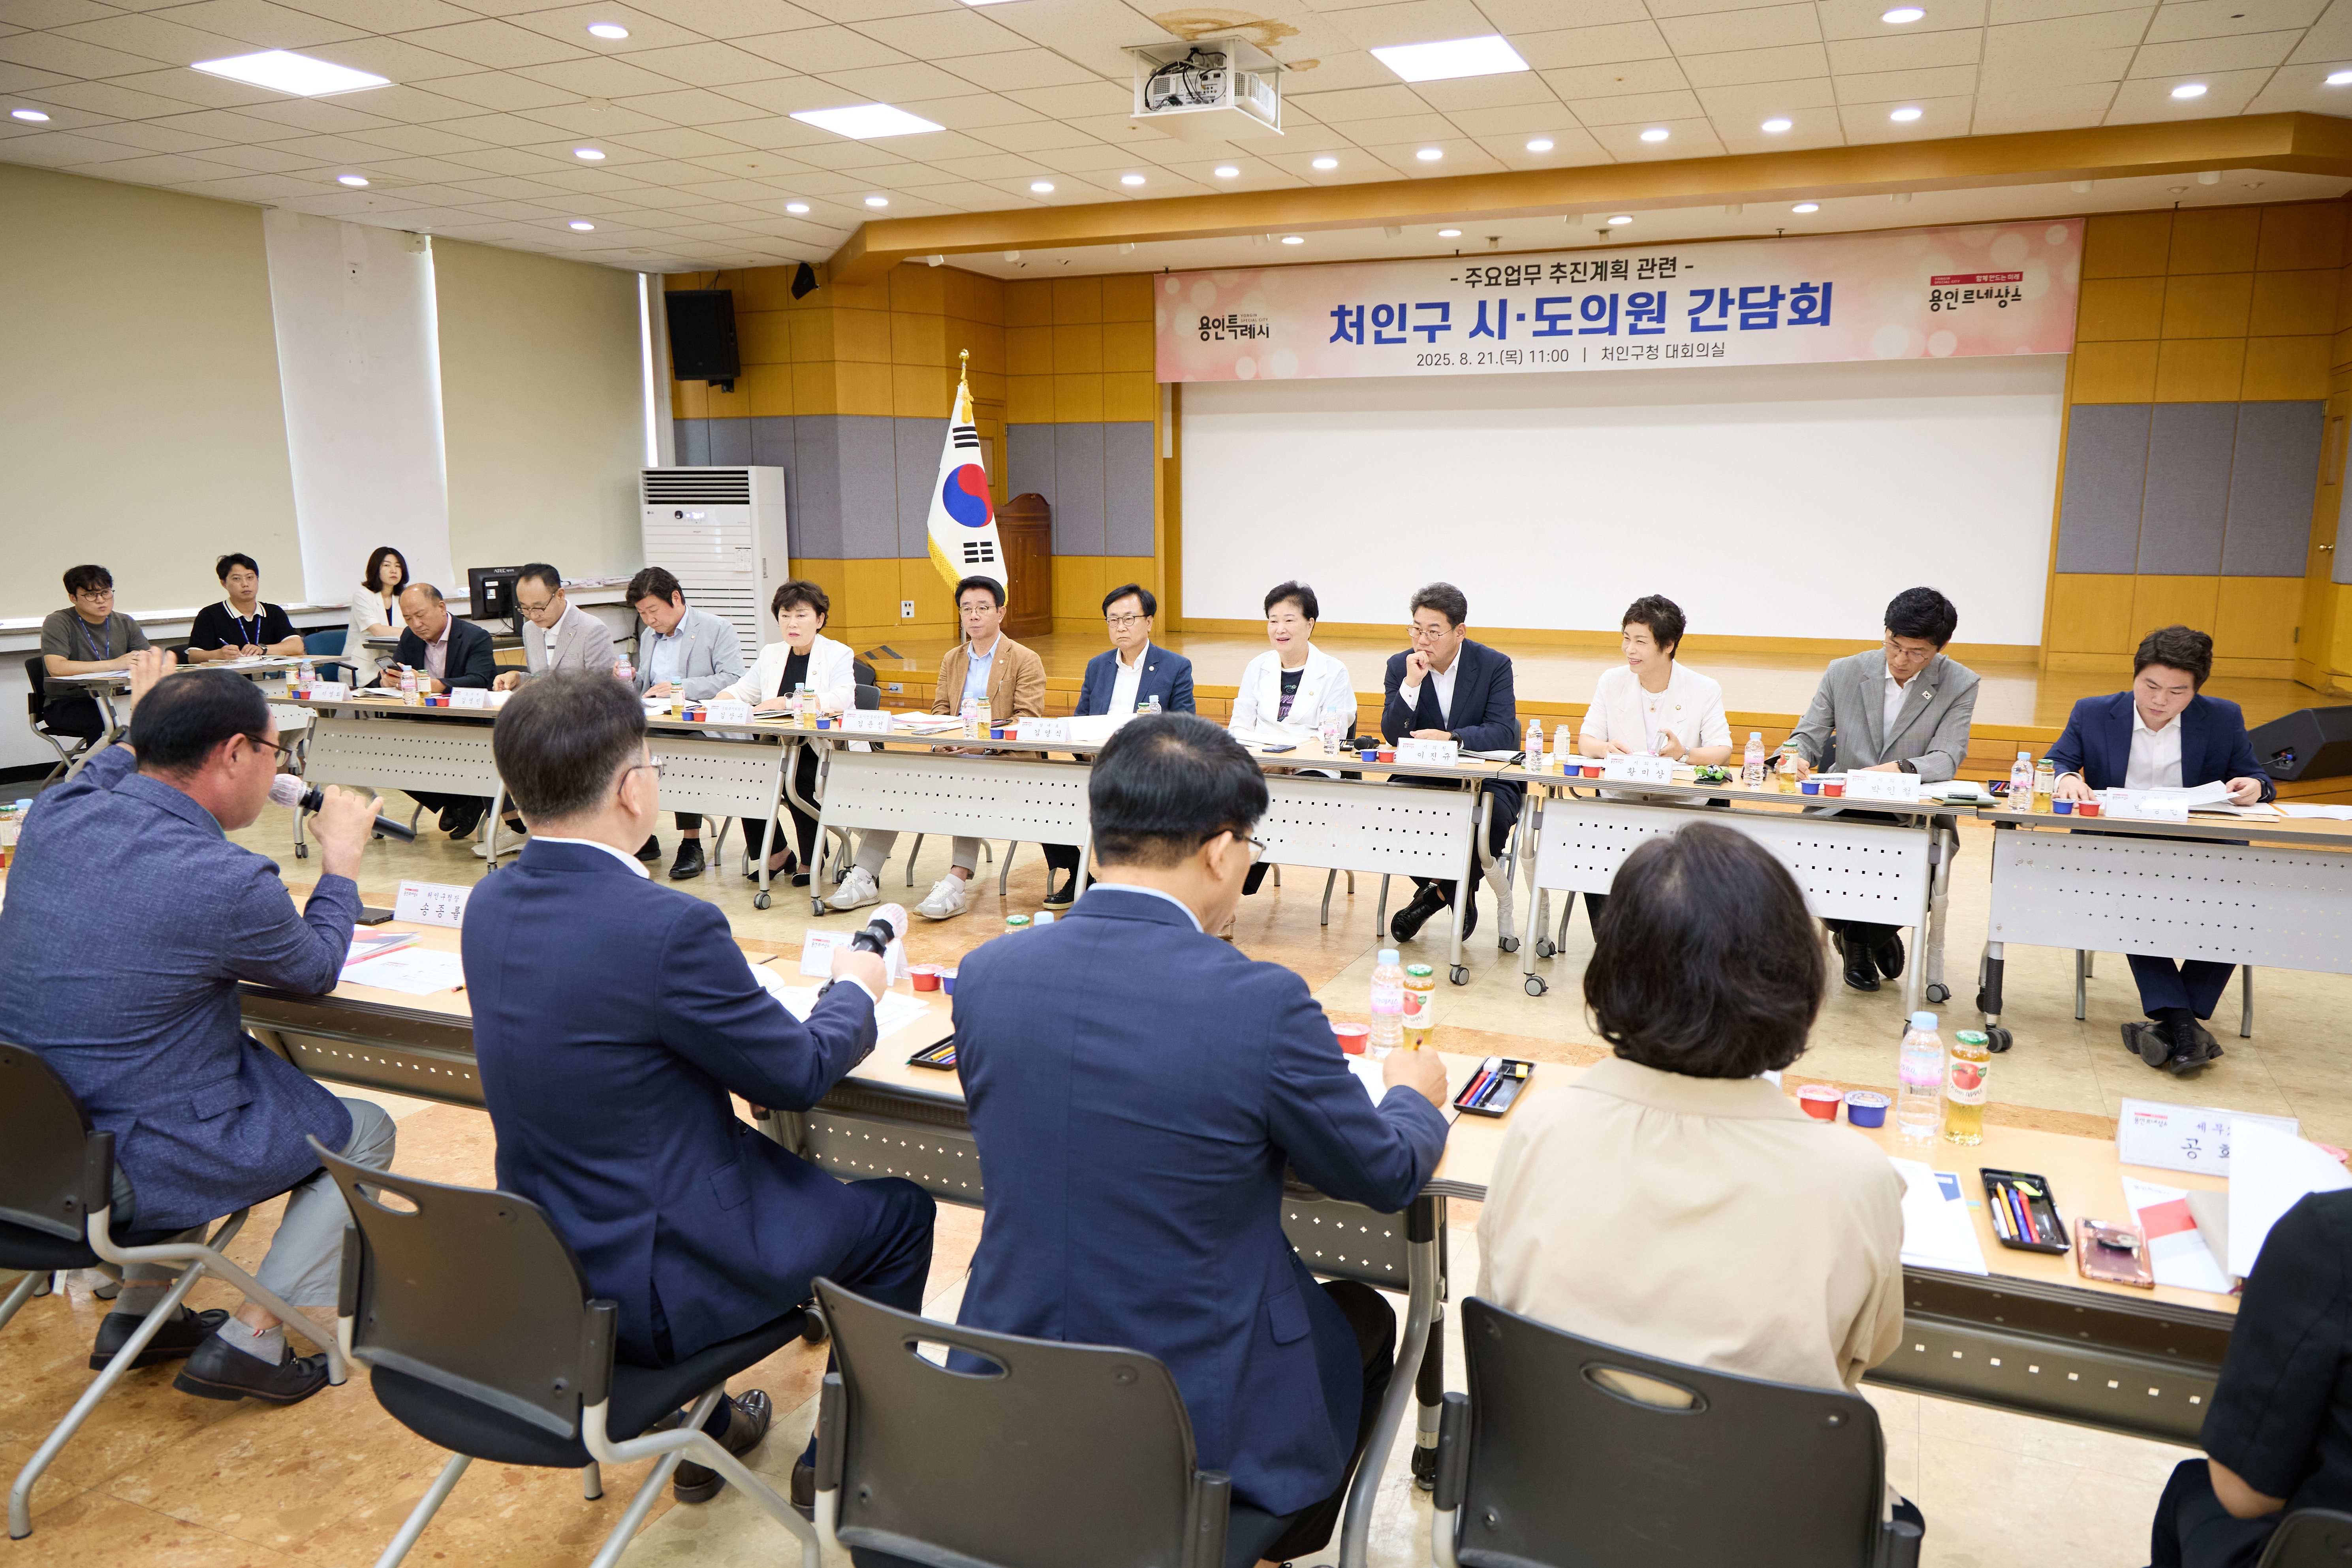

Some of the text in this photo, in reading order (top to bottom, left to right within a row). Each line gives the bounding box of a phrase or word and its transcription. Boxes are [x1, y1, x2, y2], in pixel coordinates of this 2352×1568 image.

[1465, 264, 1542, 288] 주요업무
[1549, 259, 1628, 284] 추진계획
[1637, 256, 1677, 279] 관련
[1329, 282, 1833, 345] 처인구 시·도의원 간담회
[1198, 314, 1269, 341] 용인특례시
[1417, 353, 1454, 366] 2025.
[1460, 352, 1472, 365] 8.
[1478, 349, 1523, 365] 21.(목)
[1530, 349, 1569, 363] 11:00
[1602, 344, 1659, 362] 처인구청
[1666, 342, 1725, 359] 대회의실
[427, 892, 459, 902] 처인구청장
